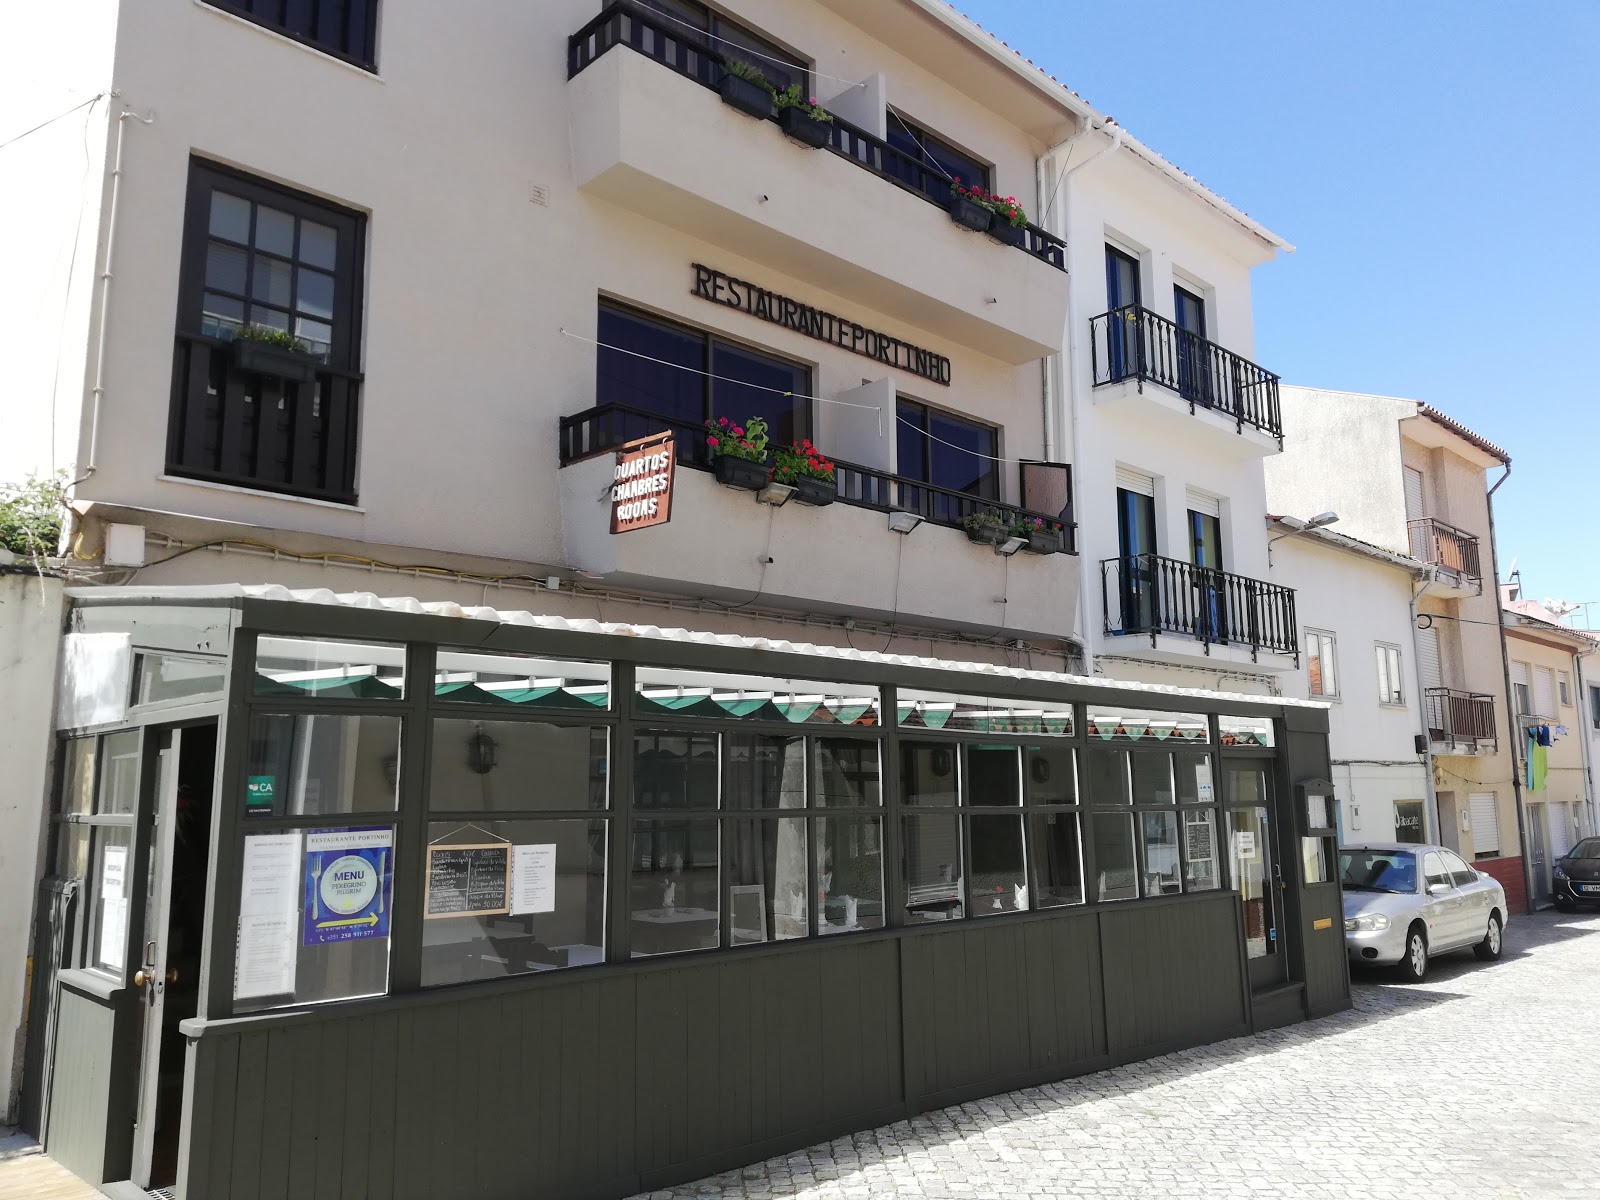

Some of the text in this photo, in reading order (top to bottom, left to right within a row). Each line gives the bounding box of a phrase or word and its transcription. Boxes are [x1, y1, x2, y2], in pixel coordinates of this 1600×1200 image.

[613, 451, 669, 480] QUARTOS
[611, 473, 668, 502] CHAMBRES
[617, 497, 658, 521] ROOMS
[260, 783, 273, 792] CA
[311, 834, 390, 844] RESTAURANTE PORTINHO
[334, 871, 365, 881] MENU
[331, 881, 367, 890] PEREGRINO
[336, 888, 362, 896] PILGRIM
